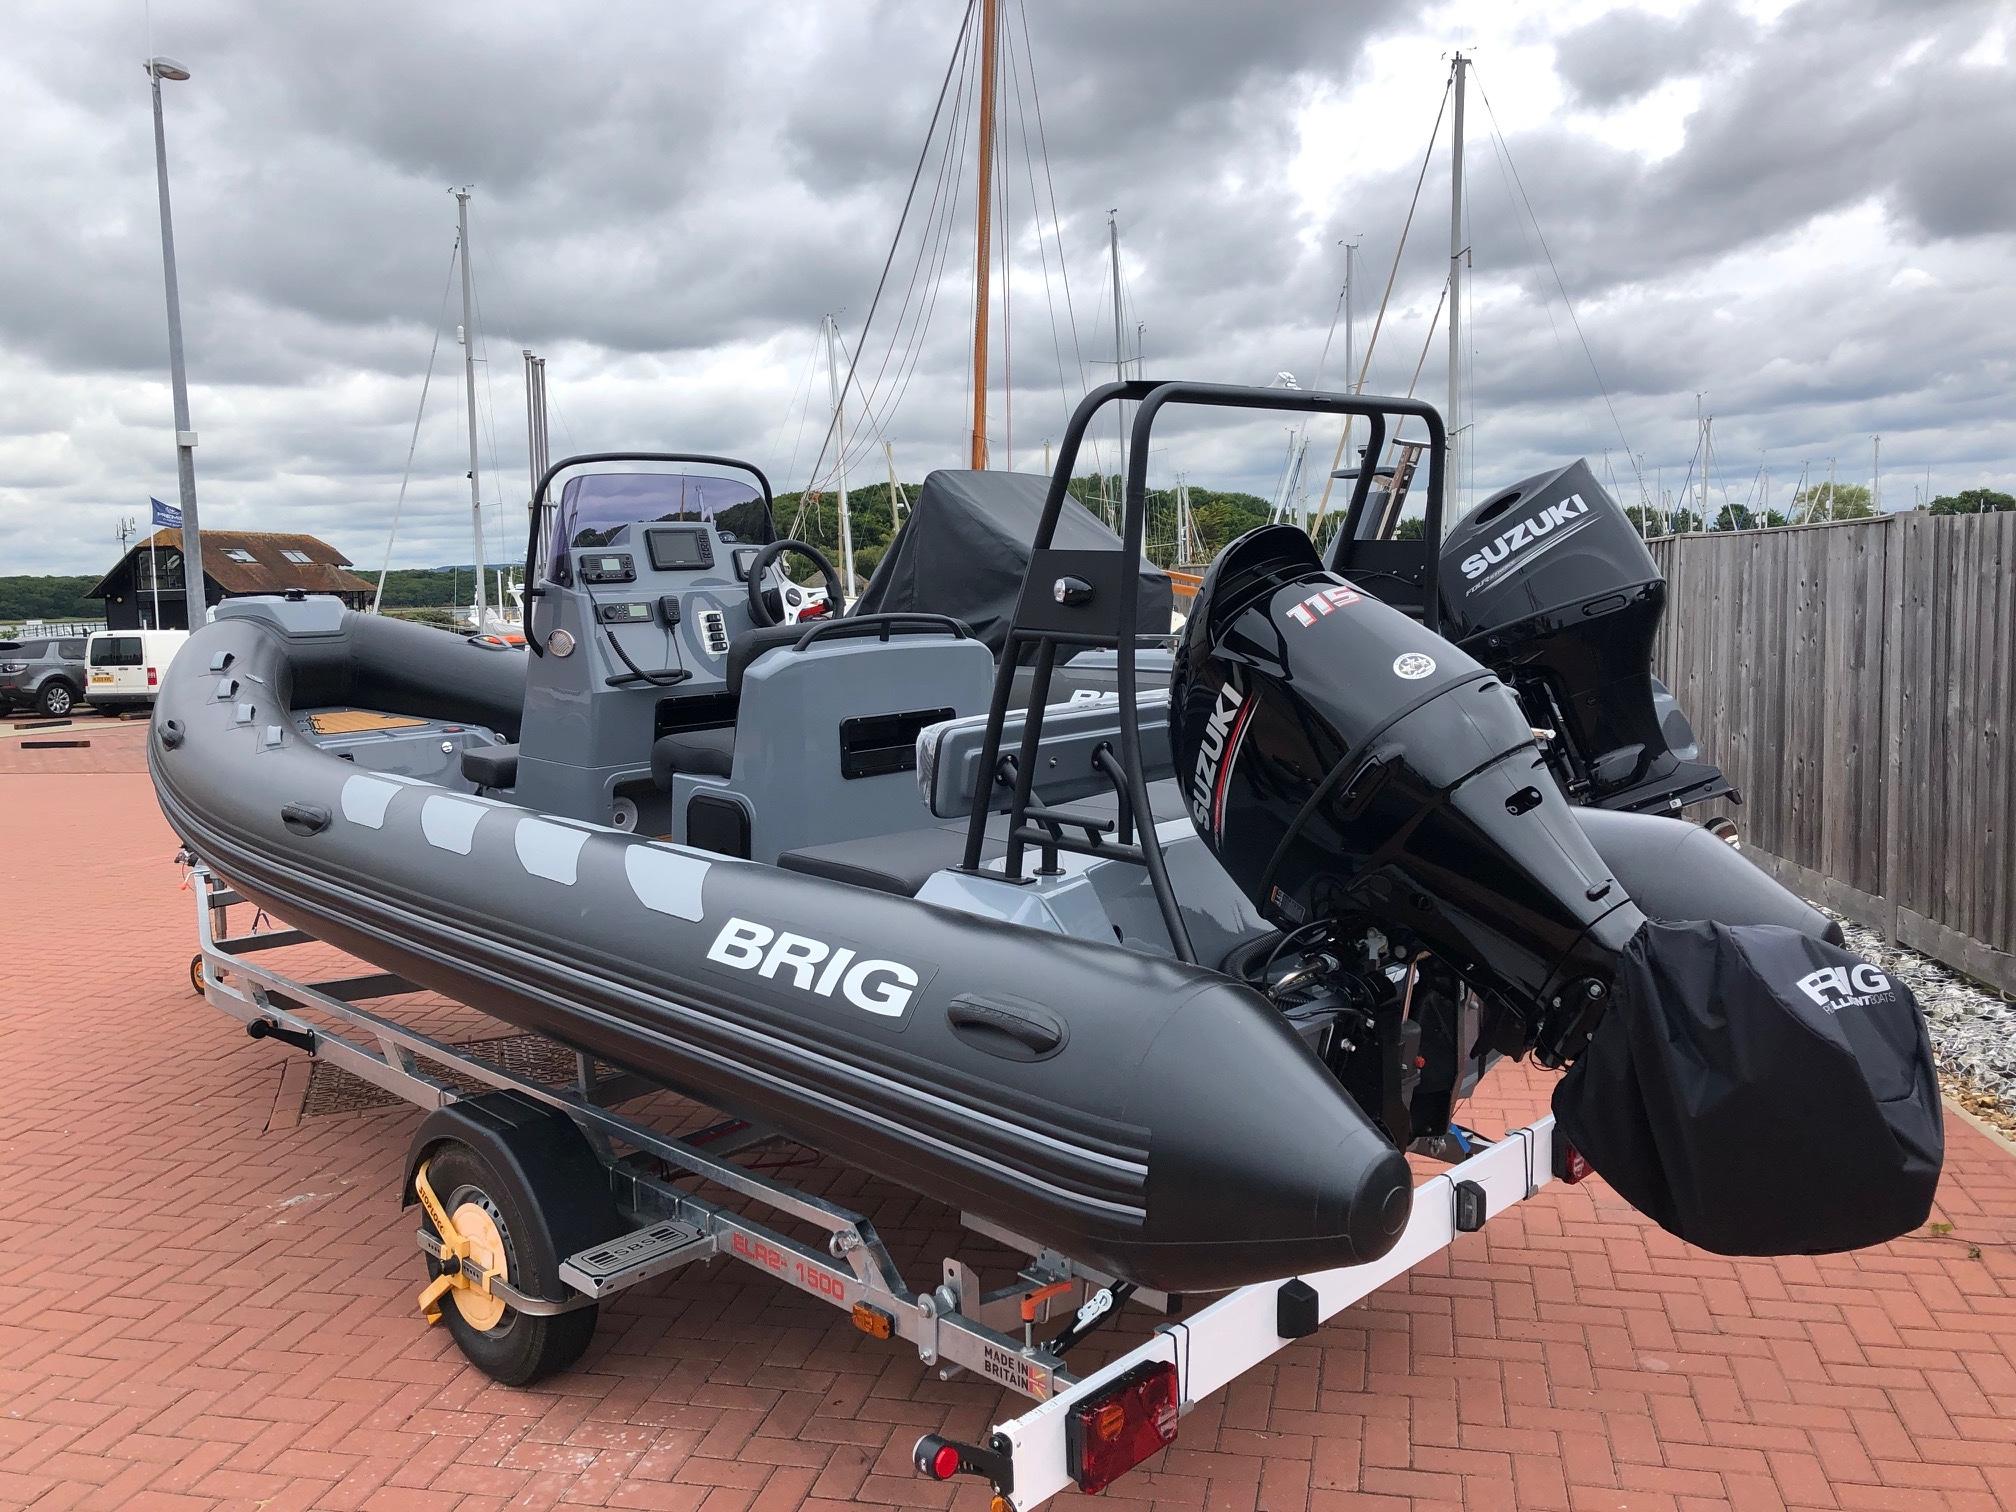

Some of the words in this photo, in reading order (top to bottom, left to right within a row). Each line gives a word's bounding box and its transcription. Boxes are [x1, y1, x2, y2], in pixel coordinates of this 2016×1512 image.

[1460, 493, 1589, 580] SUZUKI
[1285, 585, 1361, 628] 115
[1193, 682, 1243, 832] SUZUKI
[706, 917, 919, 1018] BRIG
[613, 1238, 657, 1256] SBS
[795, 1261, 845, 1301] 1500
[984, 1345, 1015, 1370] MADE
[1017, 1360, 1029, 1377] IN
[984, 1360, 1029, 1391] BRITAIN
